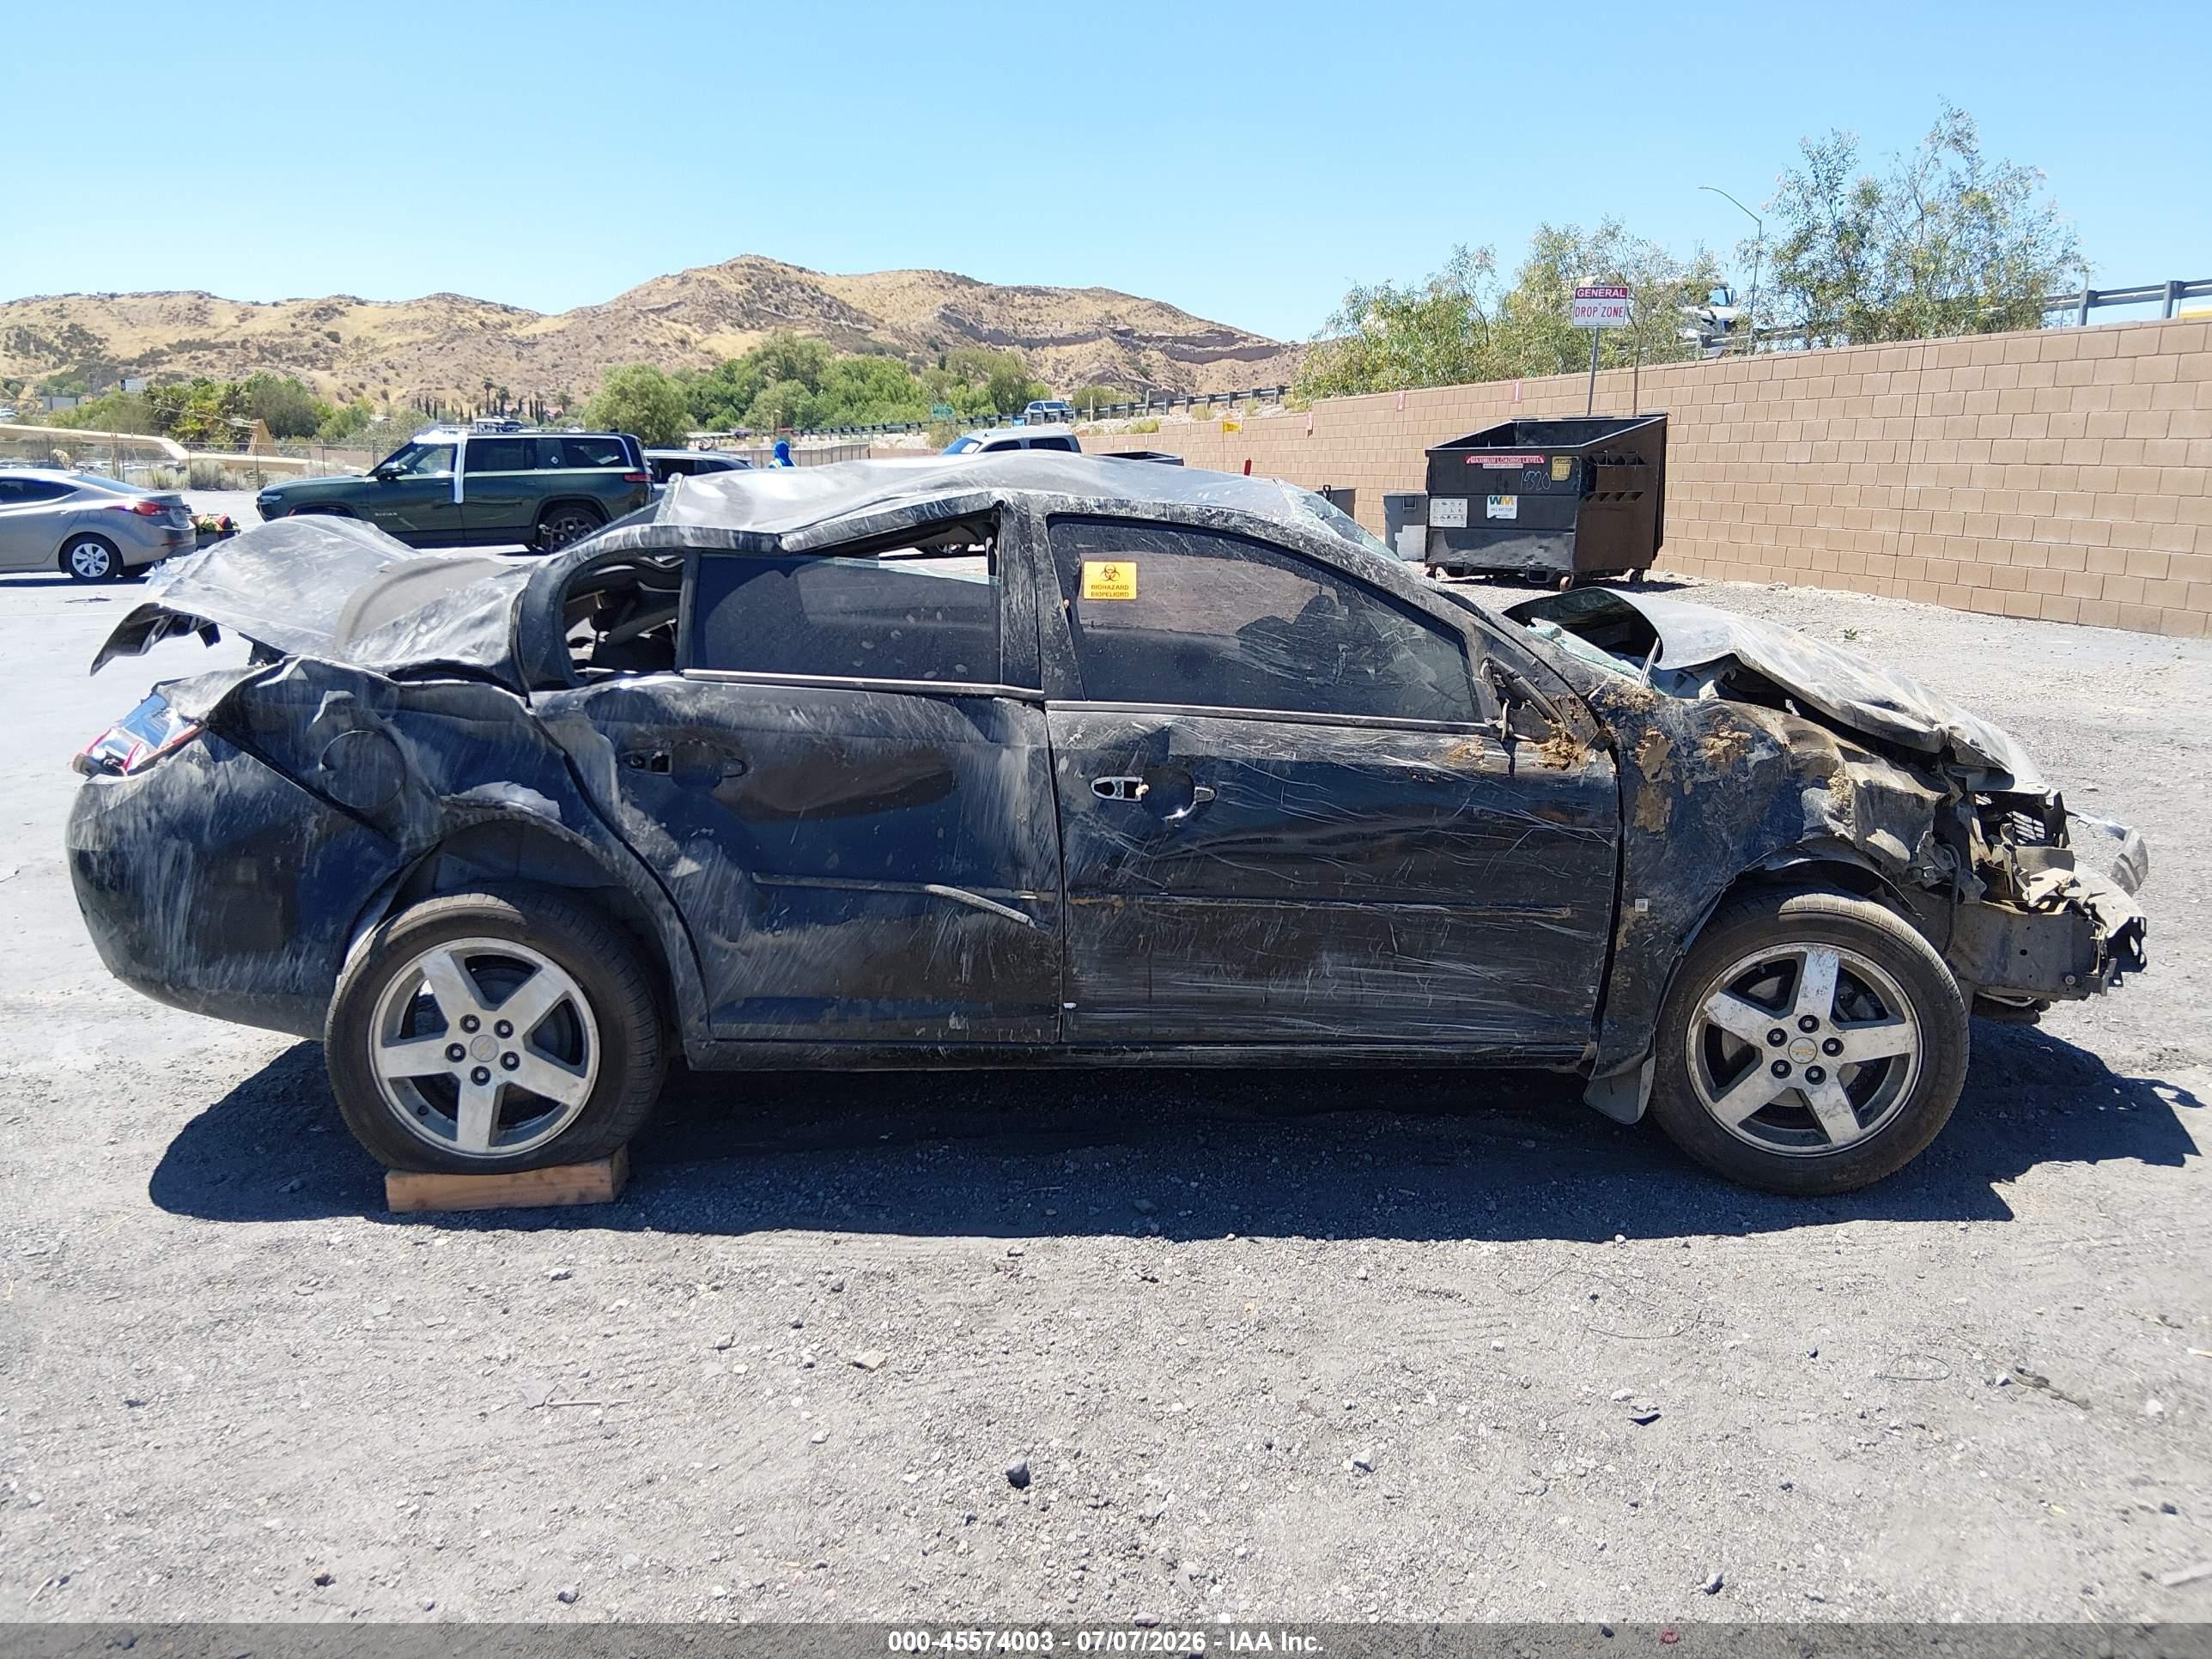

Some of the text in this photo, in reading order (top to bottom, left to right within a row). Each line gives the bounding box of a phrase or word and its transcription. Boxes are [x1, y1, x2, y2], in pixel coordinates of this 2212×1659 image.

[1577, 289, 1626, 298] GENERAL
[1575, 307, 1624, 318] DROP ZONE
[1489, 496, 1514, 505] WM
